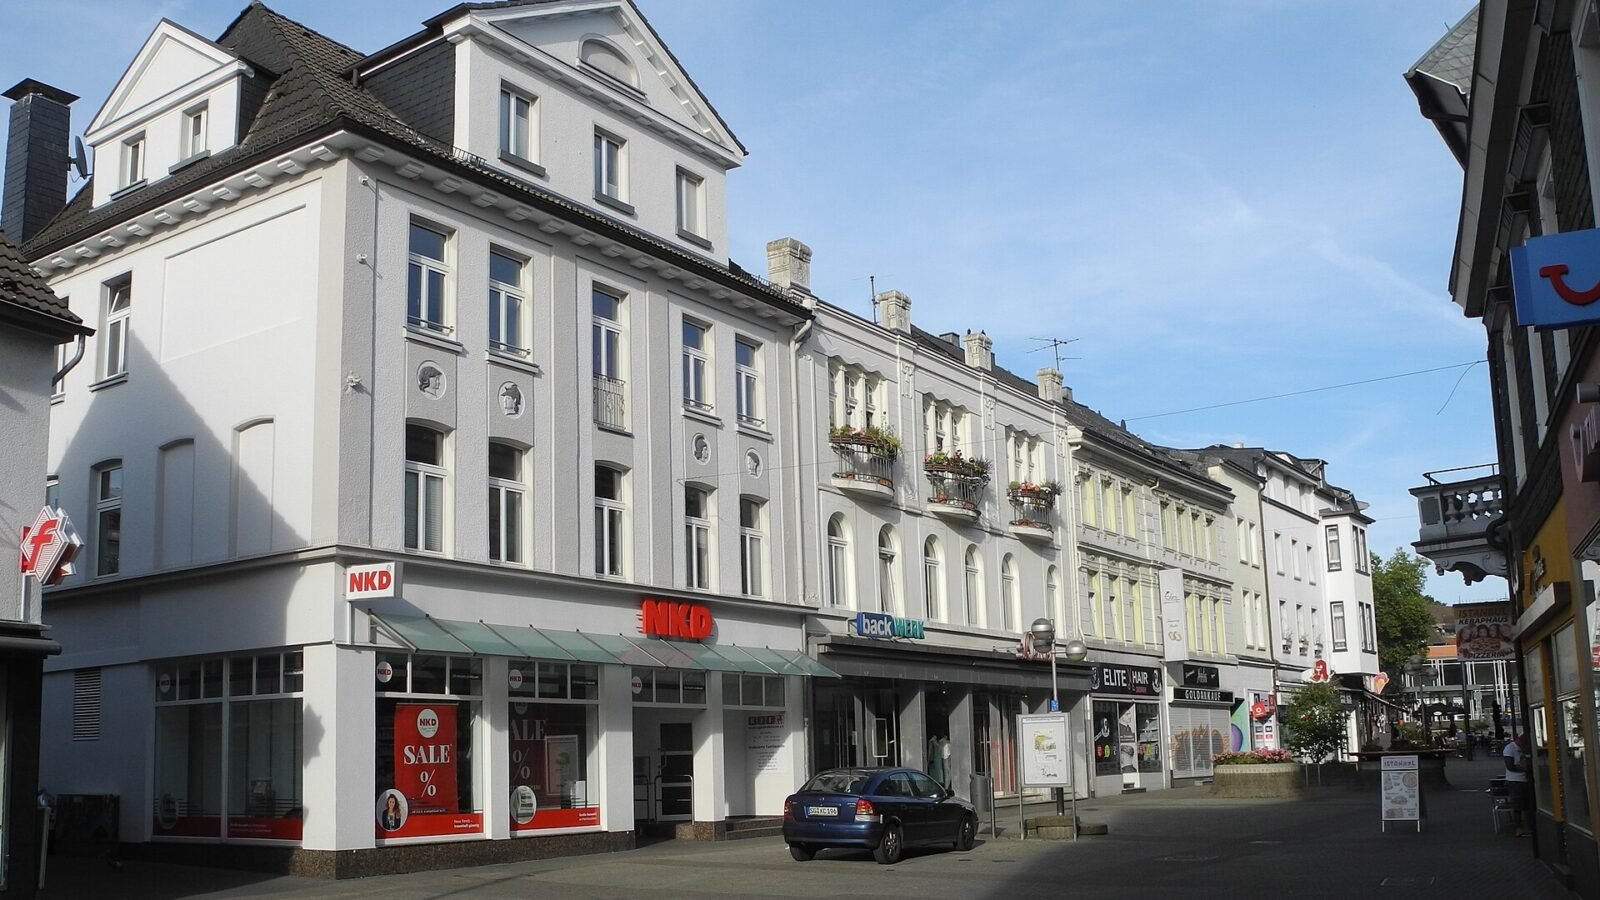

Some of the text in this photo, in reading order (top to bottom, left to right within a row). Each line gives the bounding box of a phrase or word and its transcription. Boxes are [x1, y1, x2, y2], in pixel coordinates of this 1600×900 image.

[349, 570, 392, 593] NKD
[641, 597, 714, 639] NKD
[1459, 616, 1508, 625] KEBAPHAUS
[377, 668, 392, 676] NKD
[1103, 668, 1149, 687] ELITE HAIR
[1184, 689, 1221, 701] GOLDANKAUF
[419, 718, 437, 726] NKD
[420, 769, 437, 798] %
